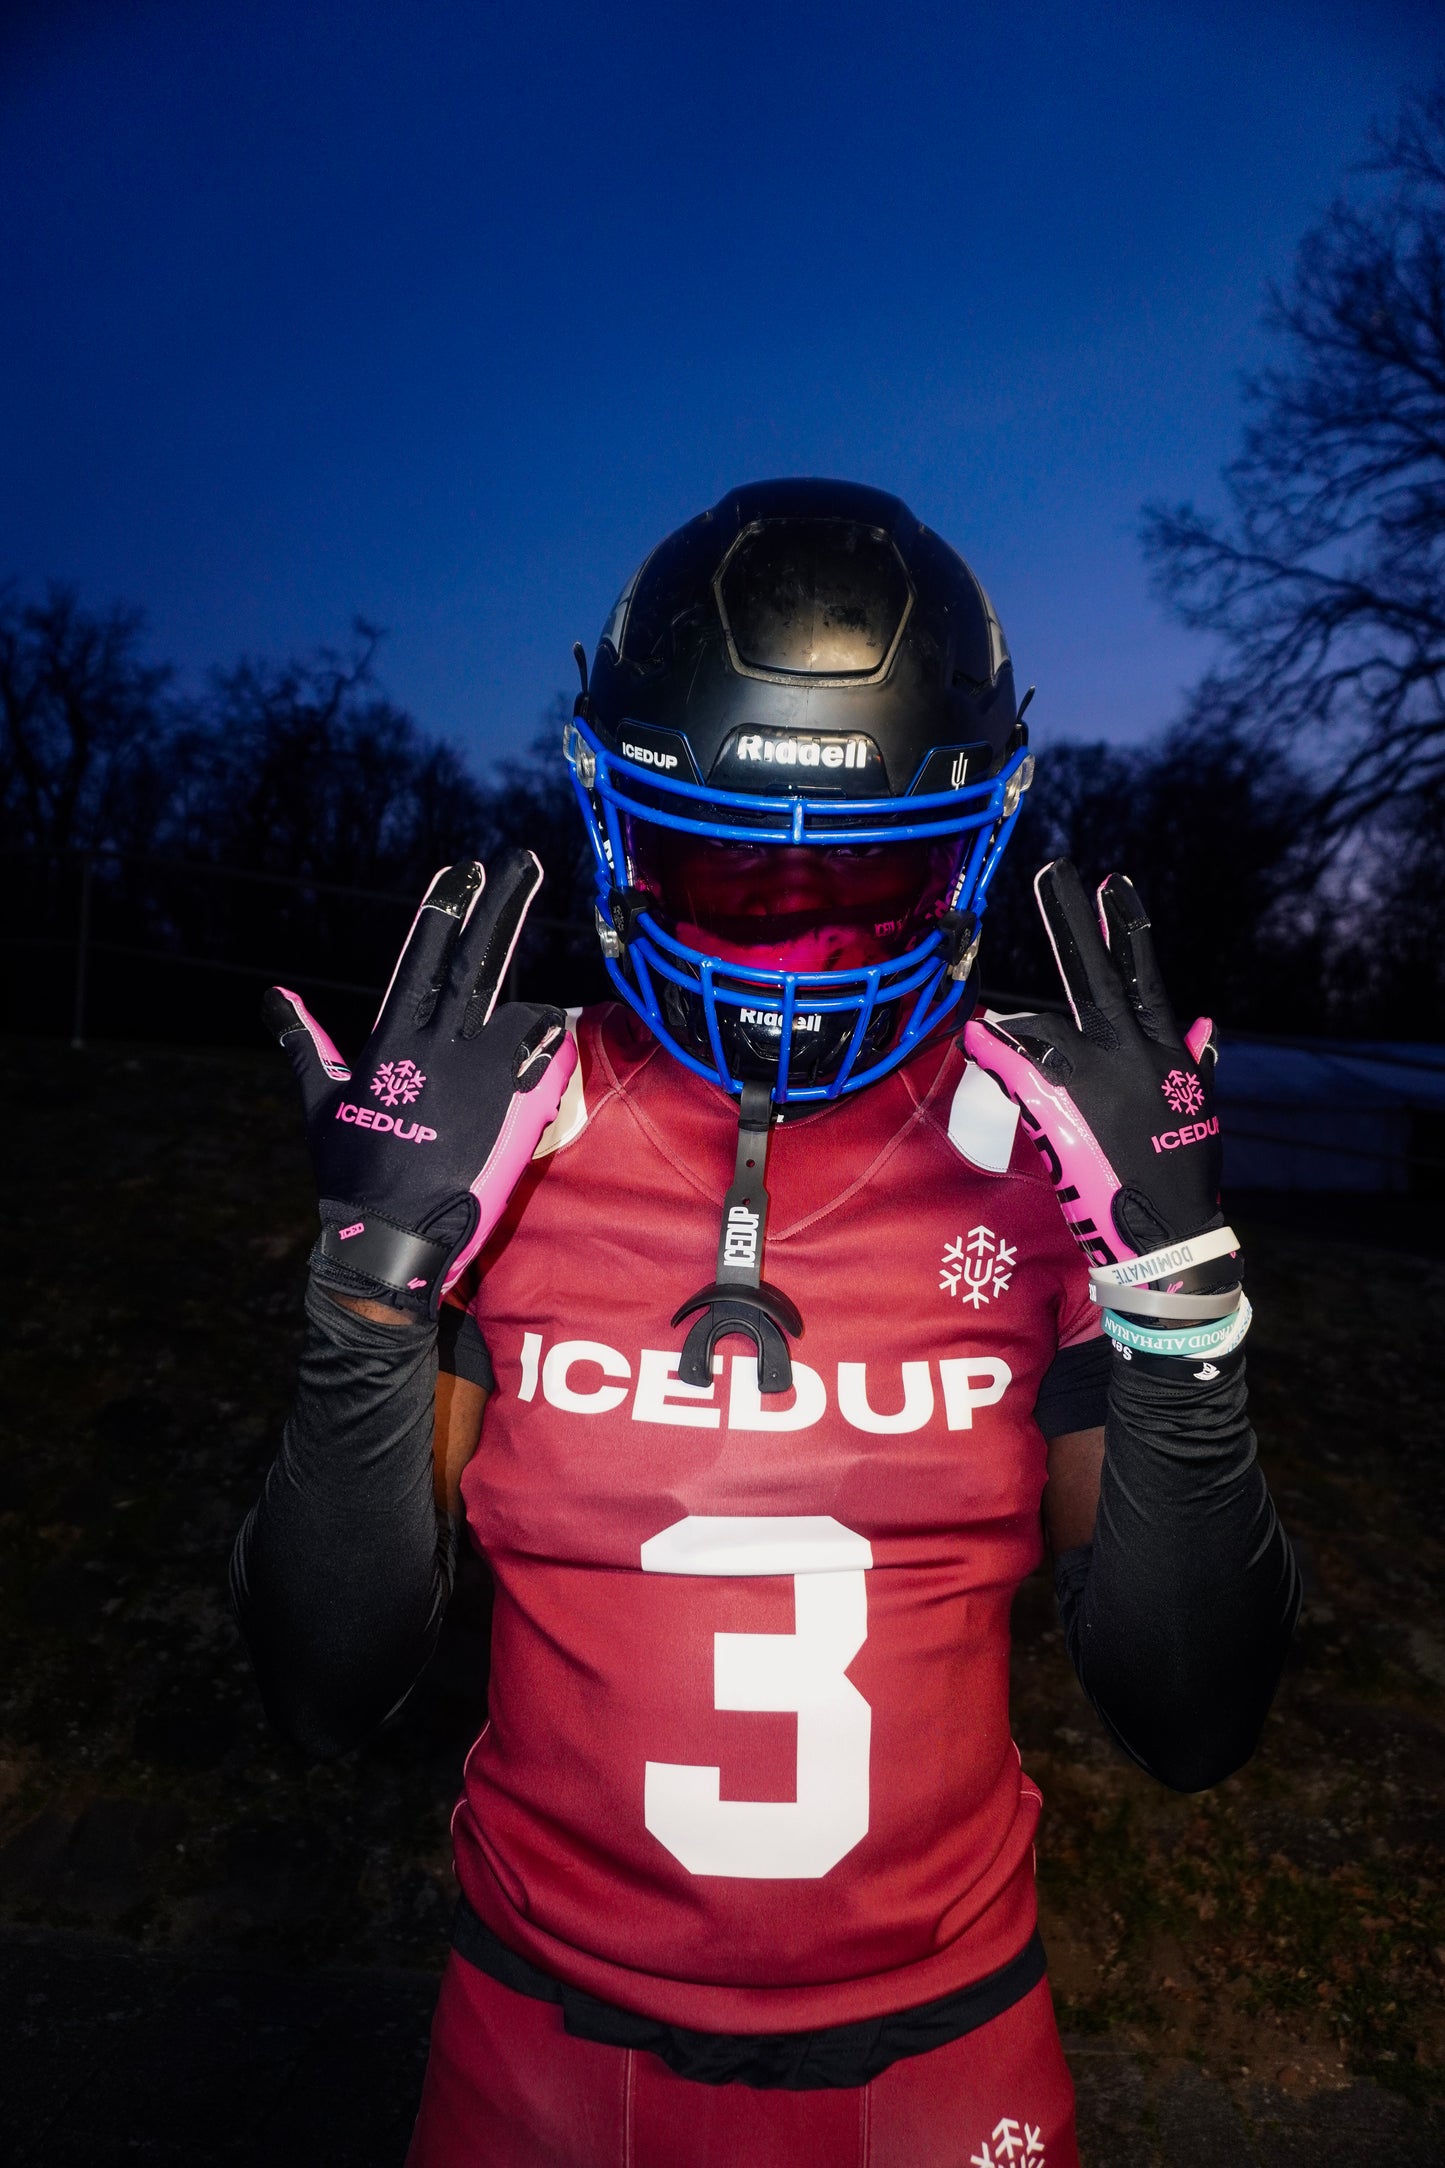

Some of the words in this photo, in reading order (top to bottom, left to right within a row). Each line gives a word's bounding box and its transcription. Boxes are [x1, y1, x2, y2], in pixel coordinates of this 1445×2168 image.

[622, 742, 678, 770] ICEDUP
[737, 735, 868, 769] Riddell
[336, 1103, 438, 1144] ICEDUP
[723, 1206, 761, 1268] ICEDUP
[1111, 1245, 1194, 1286] DOMINATE
[1104, 1316, 1186, 1351] ALPHARIAN
[517, 1331, 1014, 1435] ICEDUP
[641, 1515, 874, 1880] 3
